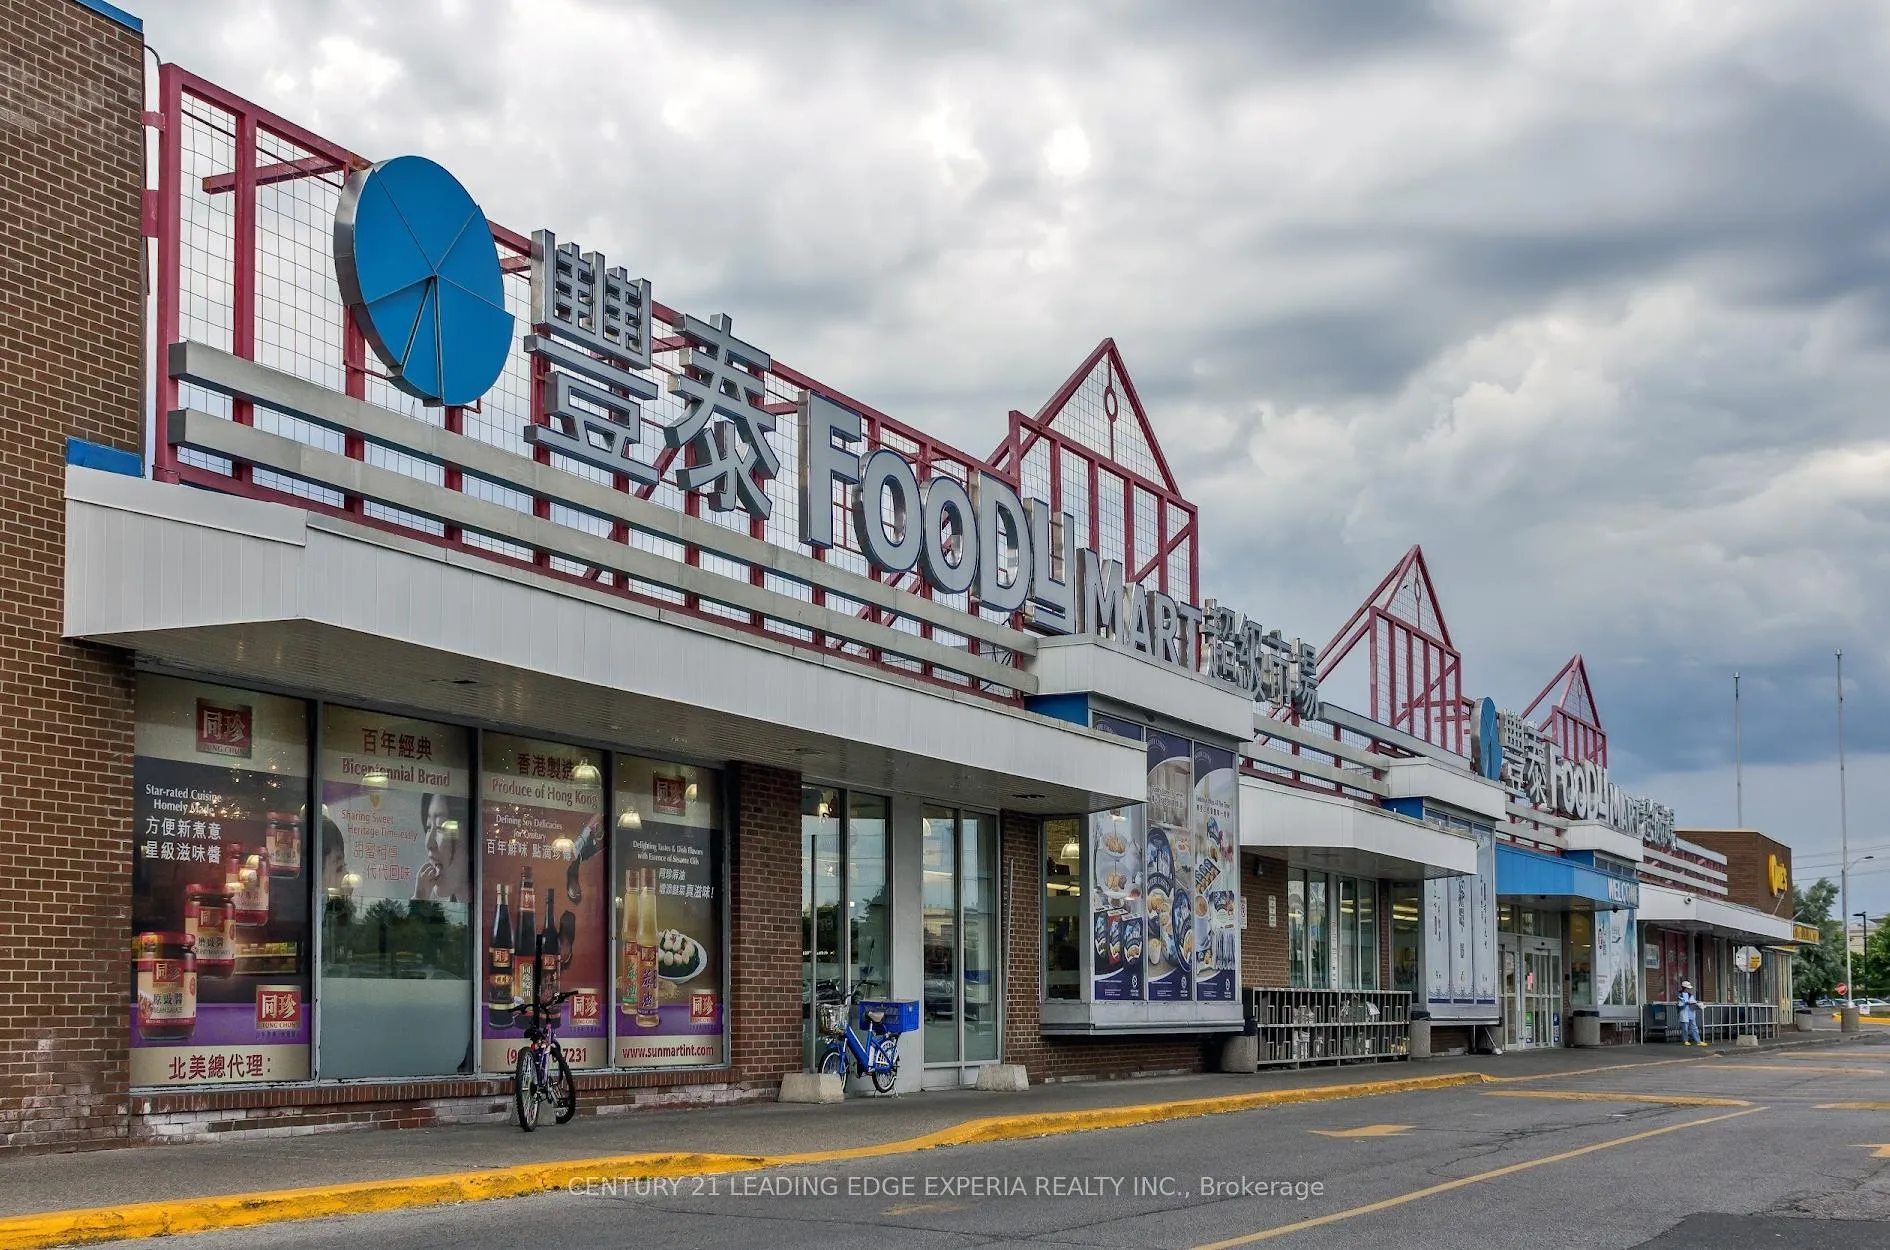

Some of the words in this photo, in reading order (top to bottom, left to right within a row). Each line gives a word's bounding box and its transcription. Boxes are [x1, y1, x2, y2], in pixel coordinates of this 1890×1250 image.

[1076, 548, 1203, 674] MART
[203, 709, 246, 743] 同珍
[361, 727, 433, 762] 百年經典
[418, 768, 450, 787] Brand
[145, 784, 189, 799] Star-rated
[191, 789, 222, 803] Cuisine
[492, 778, 532, 798] Produce
[535, 785, 545, 799] of
[548, 786, 572, 807] Hong
[575, 790, 598, 808] Kong
[153, 799, 188, 815] Homely
[191, 802, 214, 815] Made
[341, 809, 370, 824] Sharing
[1608, 782, 1641, 835] MART
[145, 815, 222, 840] 方便新煮意
[347, 826, 380, 839] Heritage
[145, 841, 221, 864] 星級滋味醬
[262, 994, 297, 1019] 同珍
[573, 995, 599, 1017] 同珍
[692, 996, 714, 1016] 同珍
[622, 1044, 714, 1059] www.sunmartint.com
